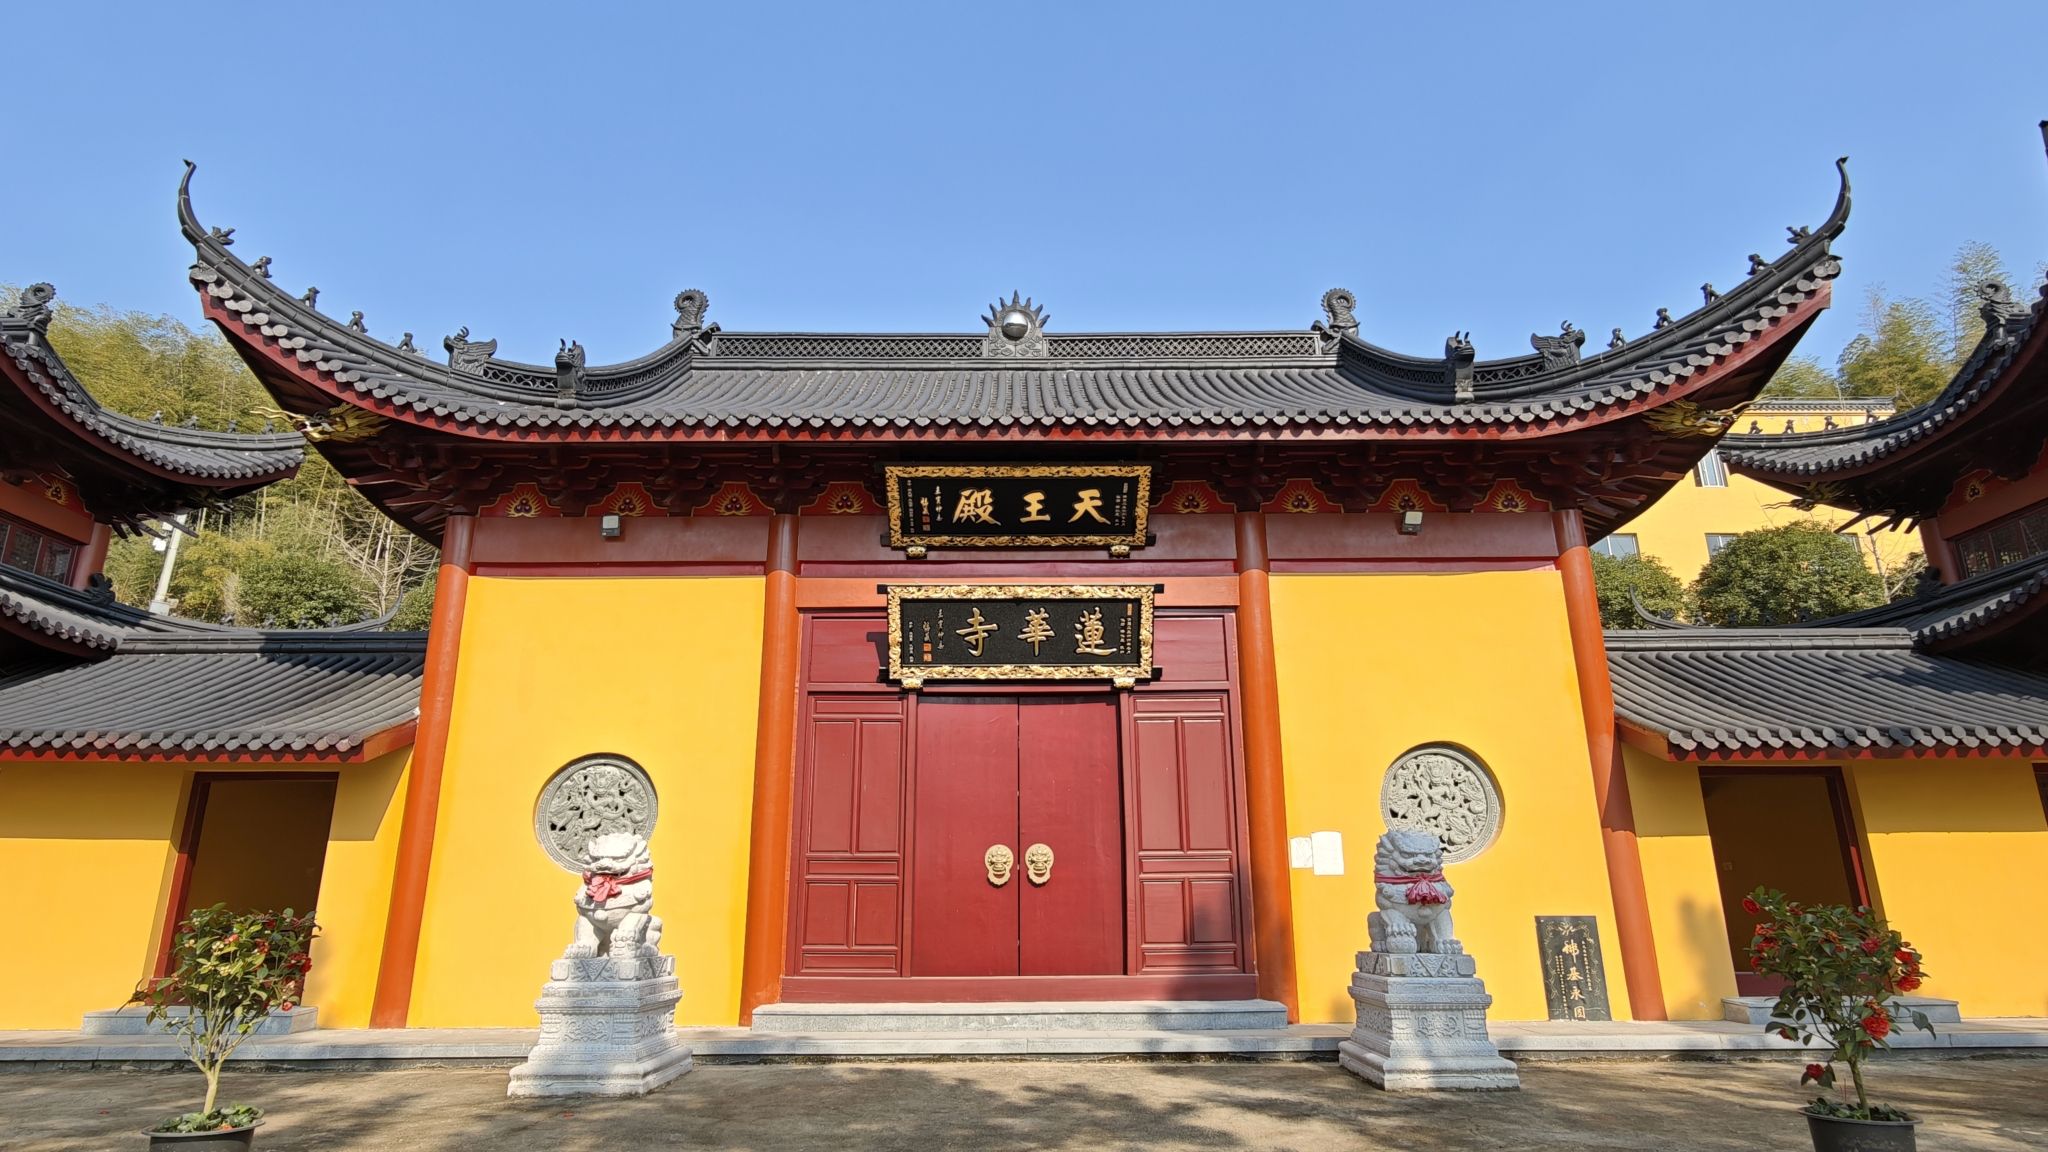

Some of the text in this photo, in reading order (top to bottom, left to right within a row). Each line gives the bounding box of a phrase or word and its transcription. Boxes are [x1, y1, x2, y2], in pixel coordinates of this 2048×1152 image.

[952, 487, 1112, 526] 天王殿
[955, 606, 1118, 657] 蓮華寺
